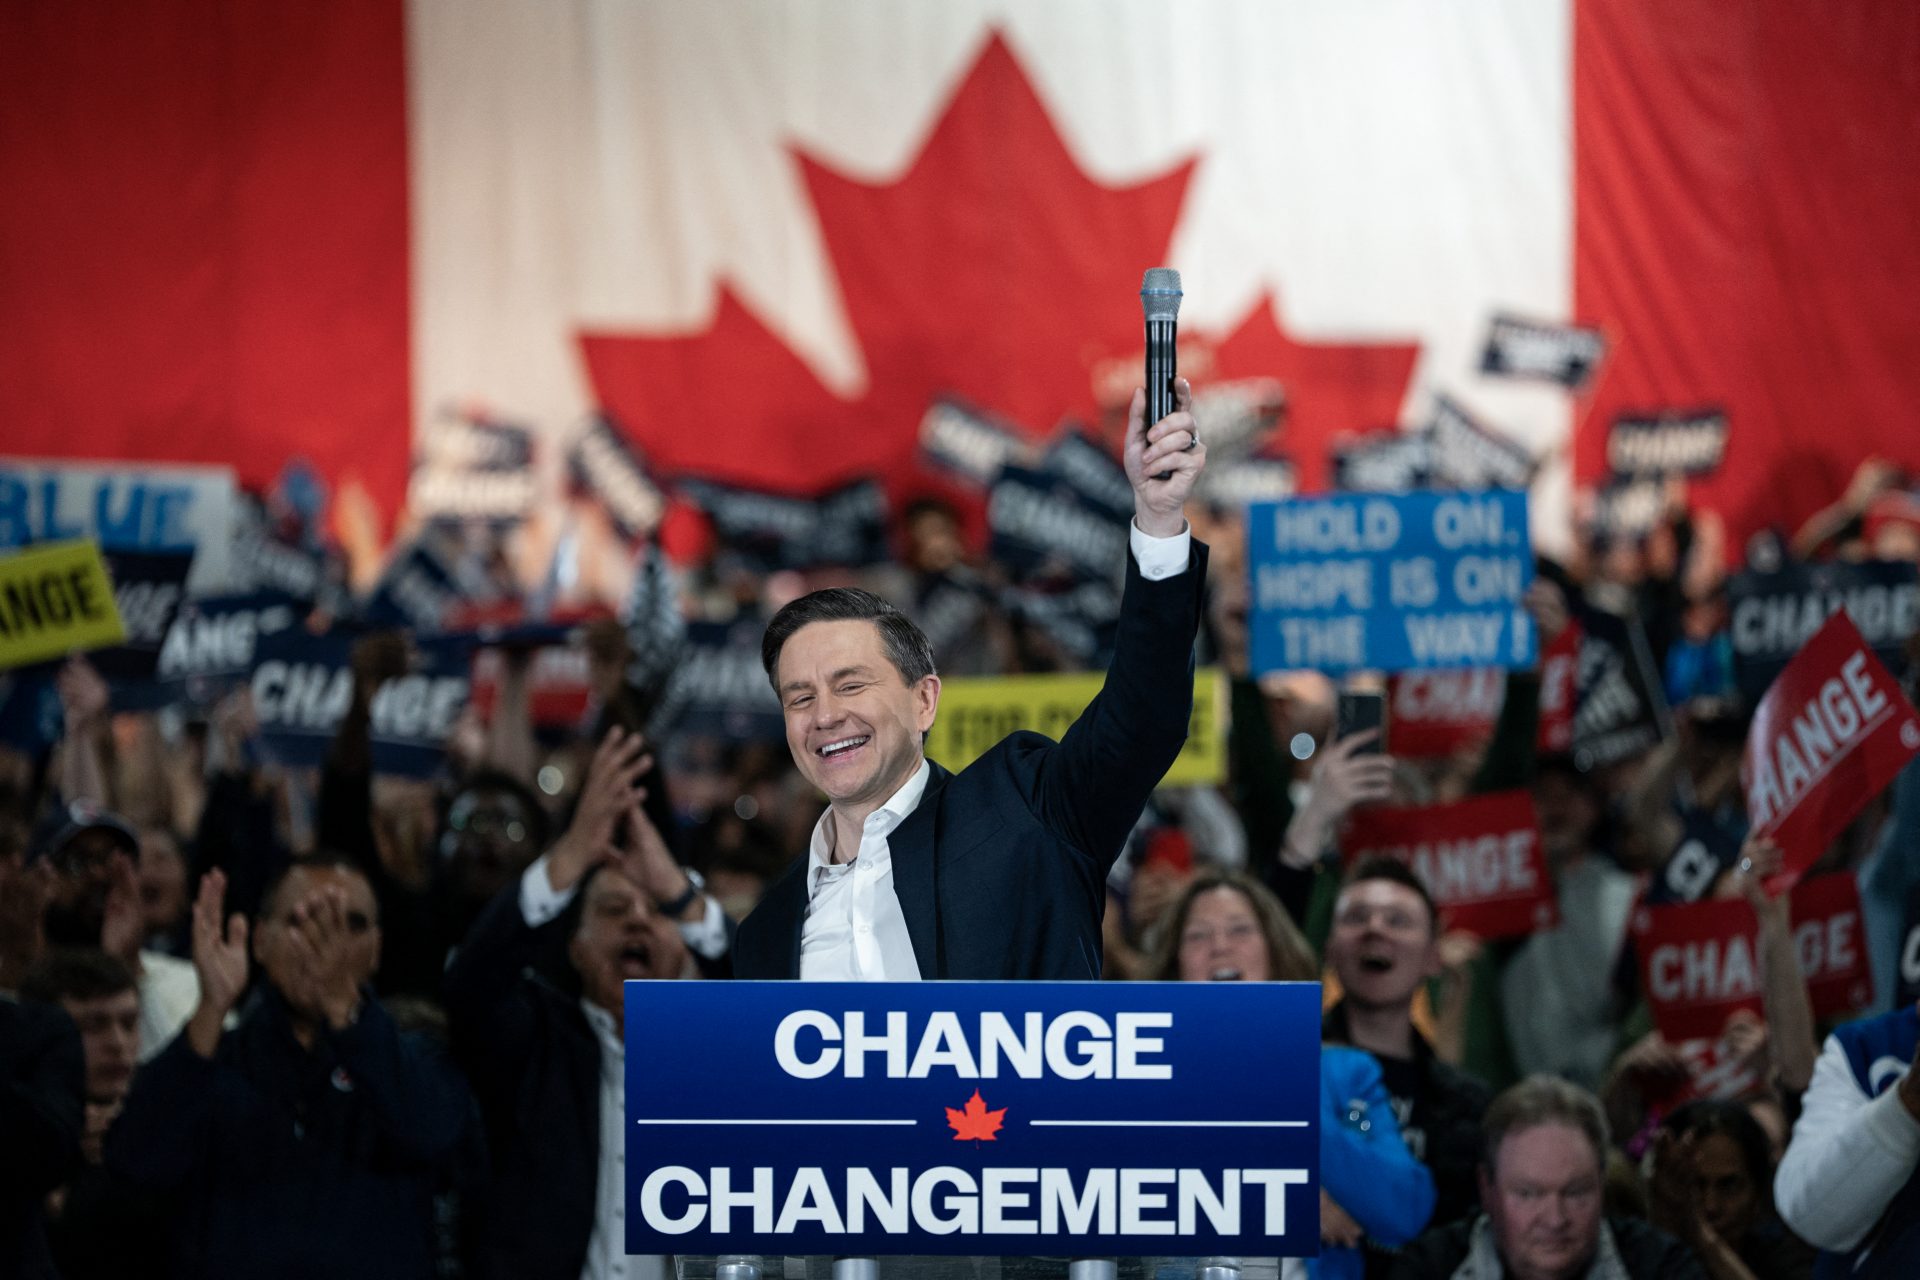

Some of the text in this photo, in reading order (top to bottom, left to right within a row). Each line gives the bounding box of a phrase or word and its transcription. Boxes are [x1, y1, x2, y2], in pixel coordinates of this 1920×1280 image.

[1274, 496, 1520, 552] HOLD ON.
[1256, 554, 1523, 610] HOPE IS ON
[1280, 614, 1366, 665] THE
[774, 1009, 1173, 1081] CHANGE
[640, 1165, 1309, 1236] CHANGEMENT
